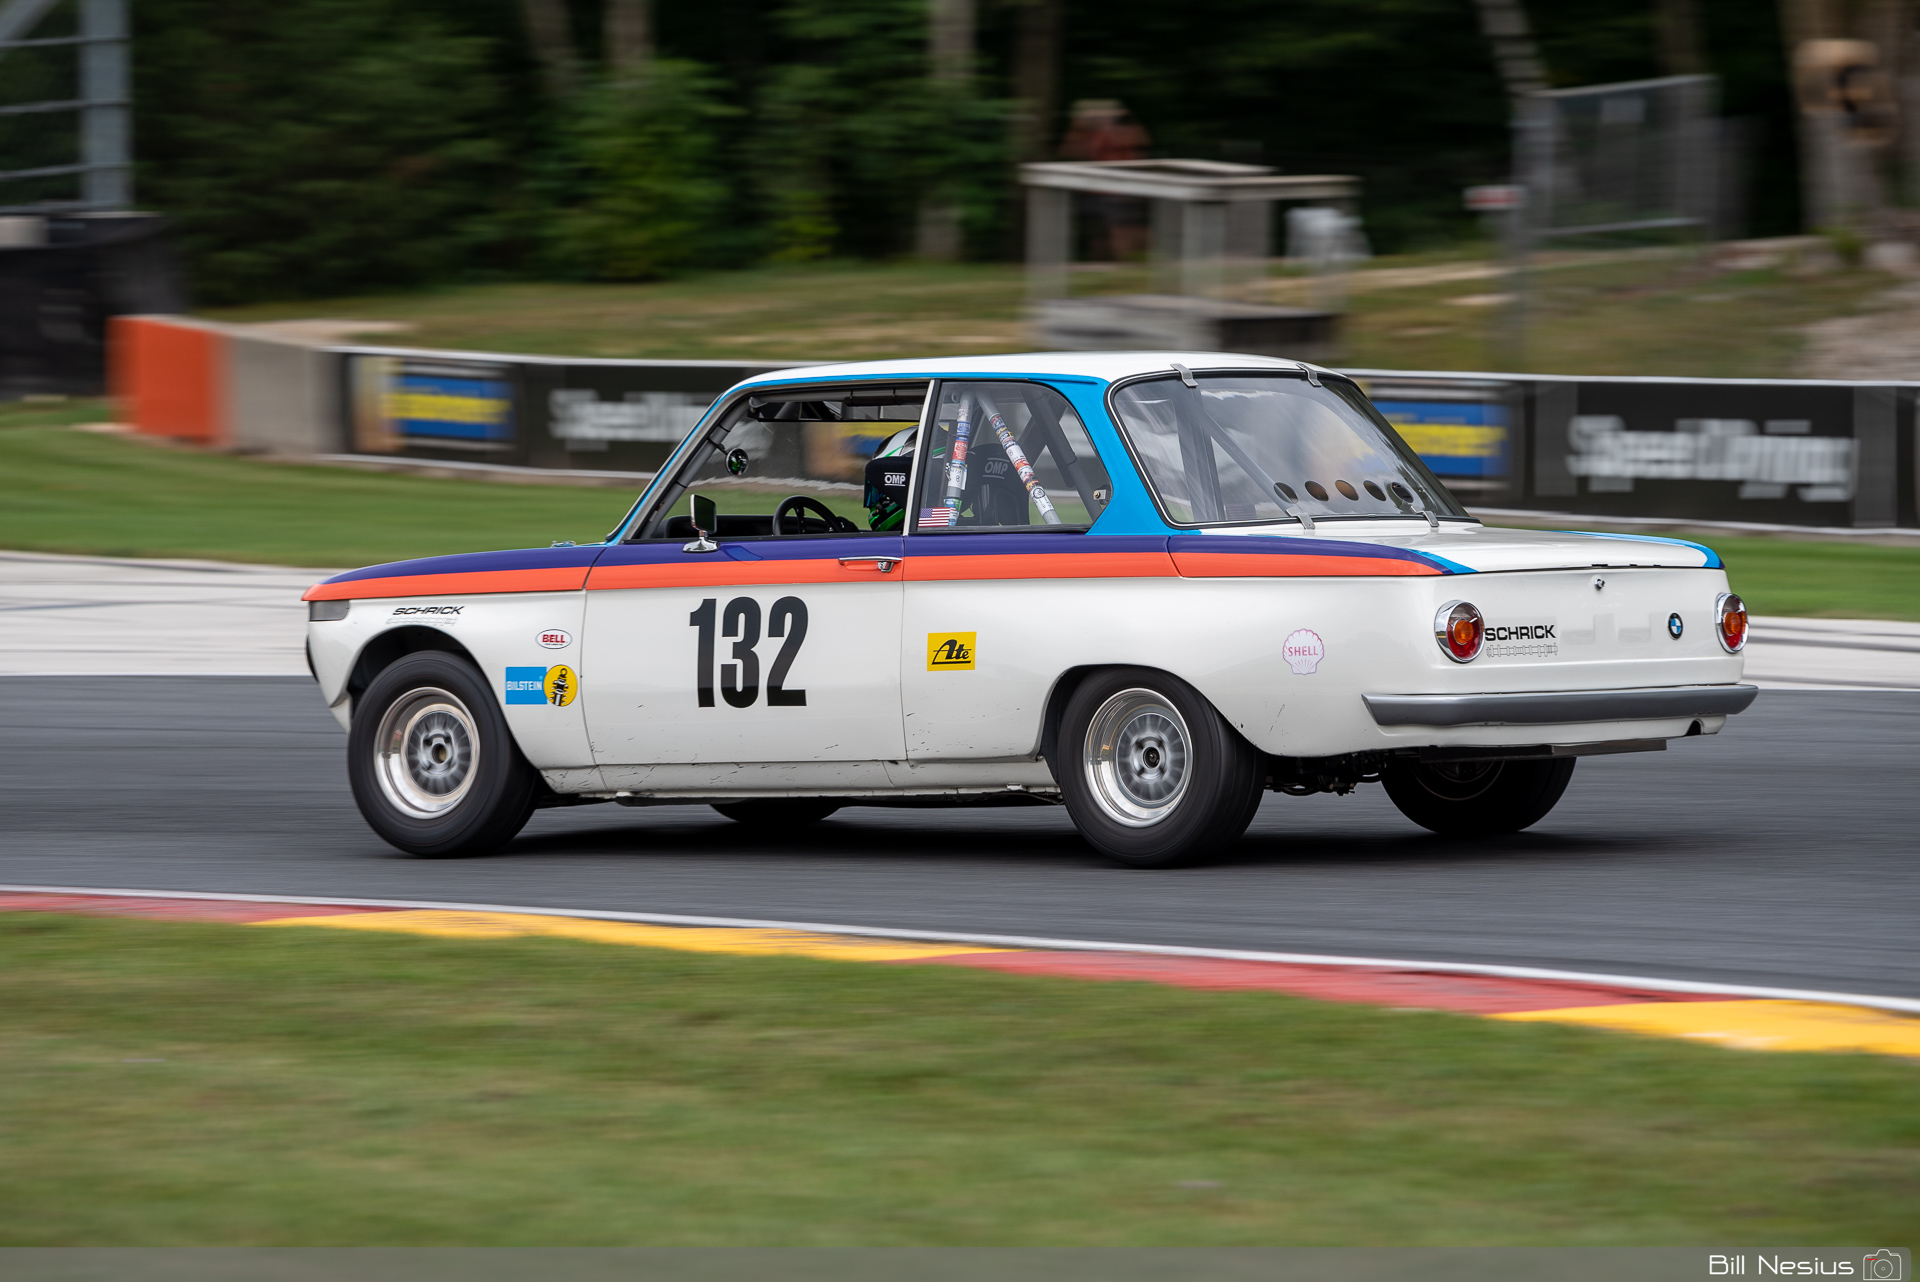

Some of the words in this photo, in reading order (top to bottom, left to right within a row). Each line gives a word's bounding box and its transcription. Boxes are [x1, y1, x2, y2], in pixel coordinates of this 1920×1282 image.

[984, 461, 1009, 475] OMP
[884, 474, 906, 485] OMP
[392, 605, 466, 616] SCHRICK
[541, 633, 566, 644] BELL
[1485, 624, 1557, 641] SCHRICK
[689, 595, 809, 709] 132
[931, 638, 973, 666] Ate
[1287, 645, 1319, 657] SHELL
[506, 680, 543, 691] BILSTEIN
